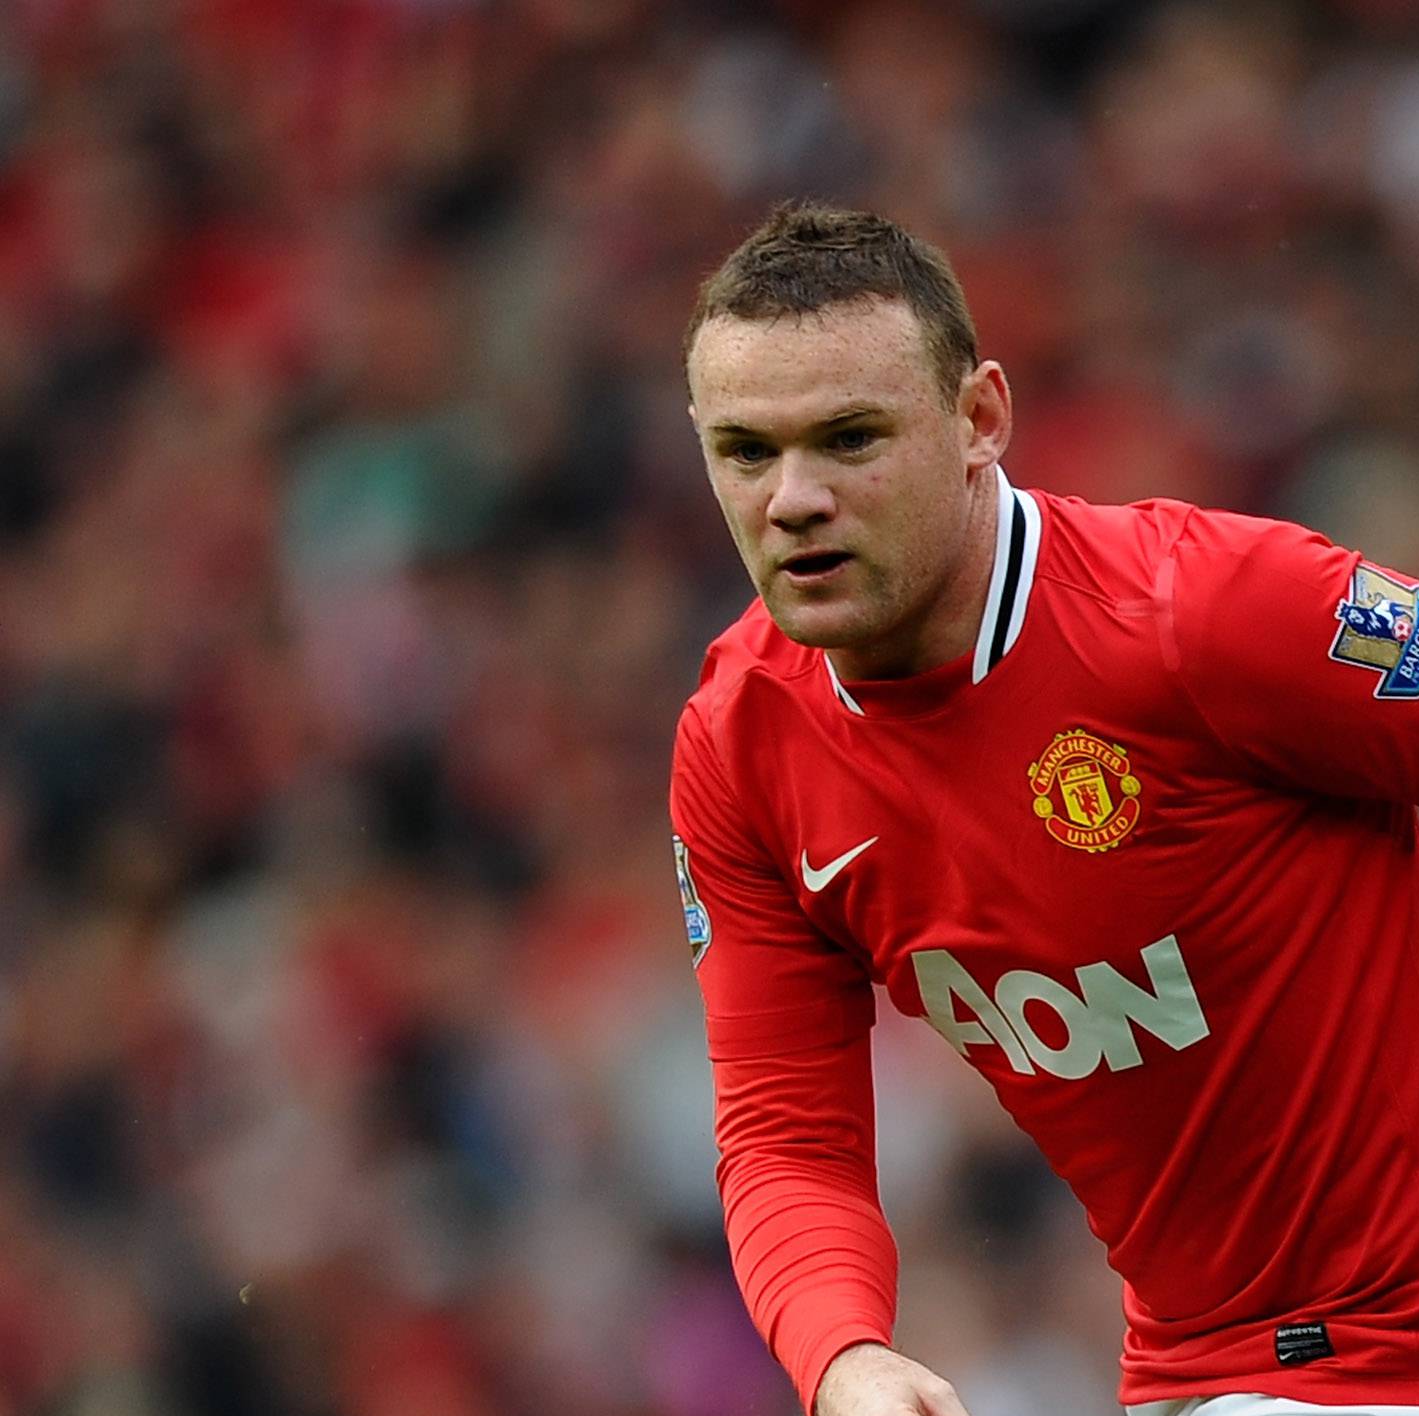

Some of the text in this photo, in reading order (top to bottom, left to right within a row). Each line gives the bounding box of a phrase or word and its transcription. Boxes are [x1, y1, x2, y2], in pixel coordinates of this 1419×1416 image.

[1036, 739, 1121, 786] MANCHESTER
[1067, 816, 1129, 844] UNITED
[911, 934, 1211, 1081] AON
